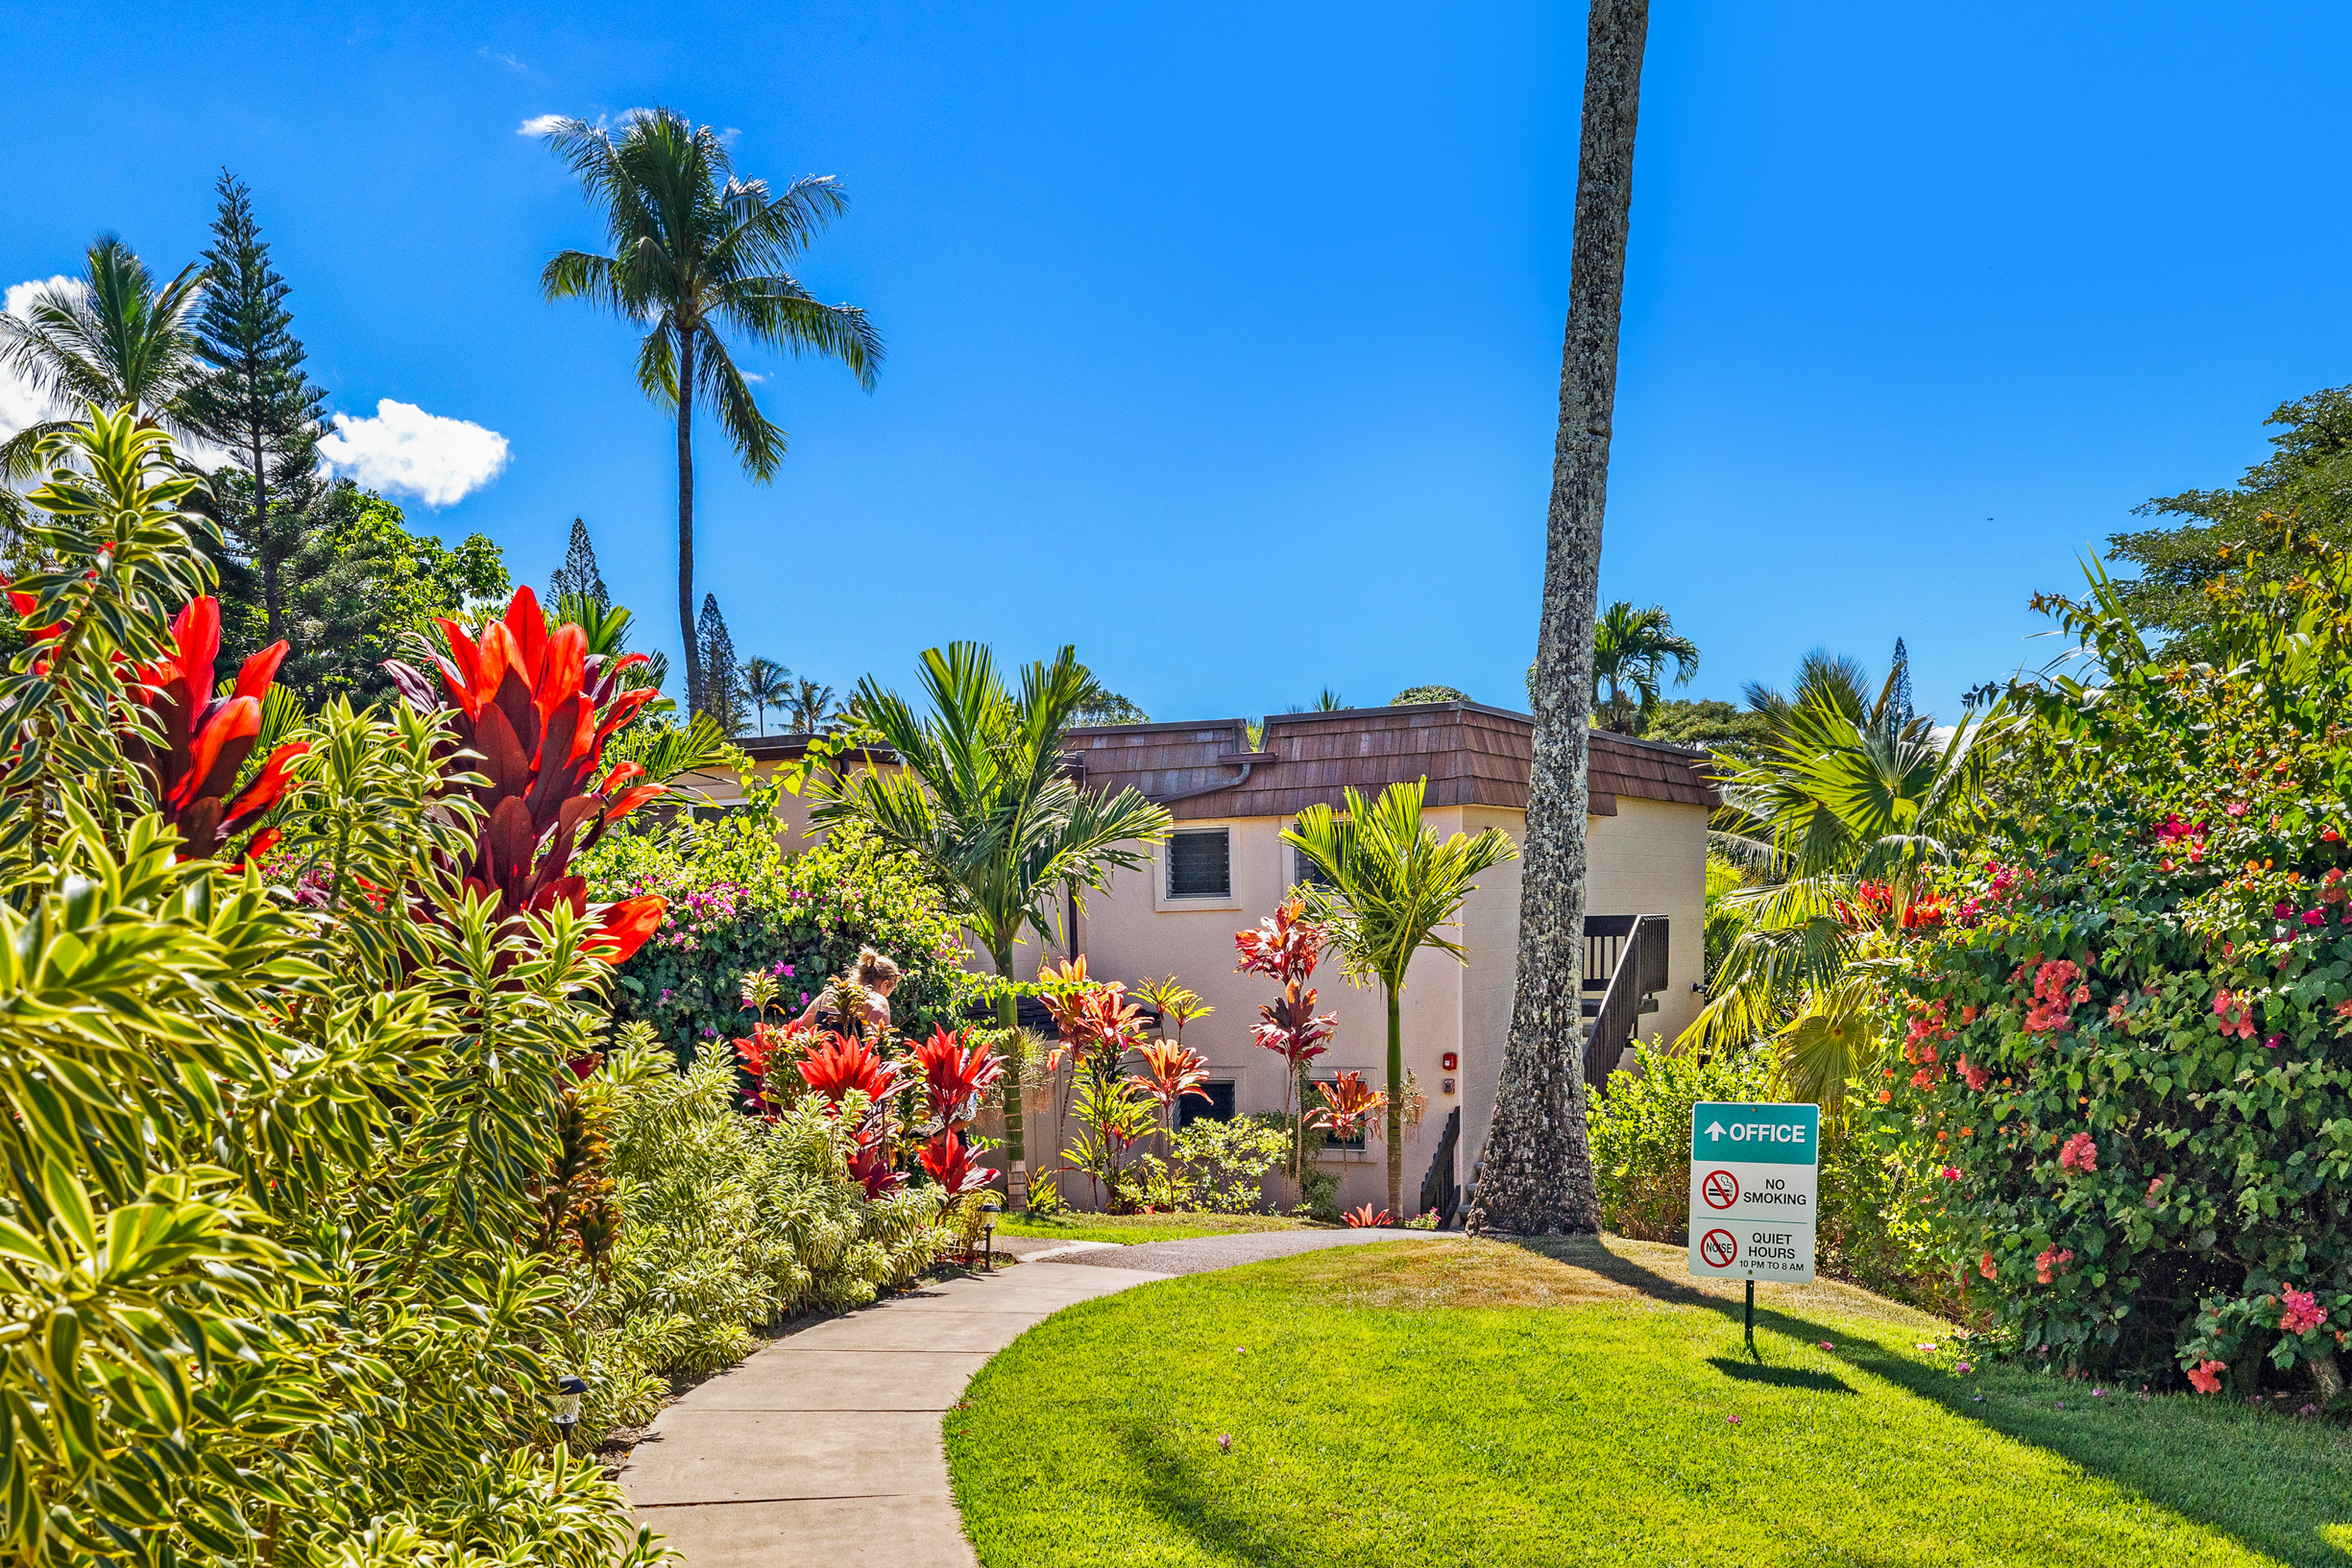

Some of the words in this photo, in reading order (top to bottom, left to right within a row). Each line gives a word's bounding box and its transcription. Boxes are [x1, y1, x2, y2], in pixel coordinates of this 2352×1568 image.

[1729, 1122, 1806, 1143] OFFICE
[1765, 1179, 1785, 1191] NO
[1743, 1192, 1806, 1205] SMOKING
[1752, 1232, 1792, 1244] QUIET
[1706, 1242, 1733, 1253] NOISE
[1748, 1245, 1796, 1259] HOURS
[1767, 1261, 1780, 1269] TO
[1782, 1262, 1787, 1270] 8
[1789, 1263, 1805, 1271] AM
